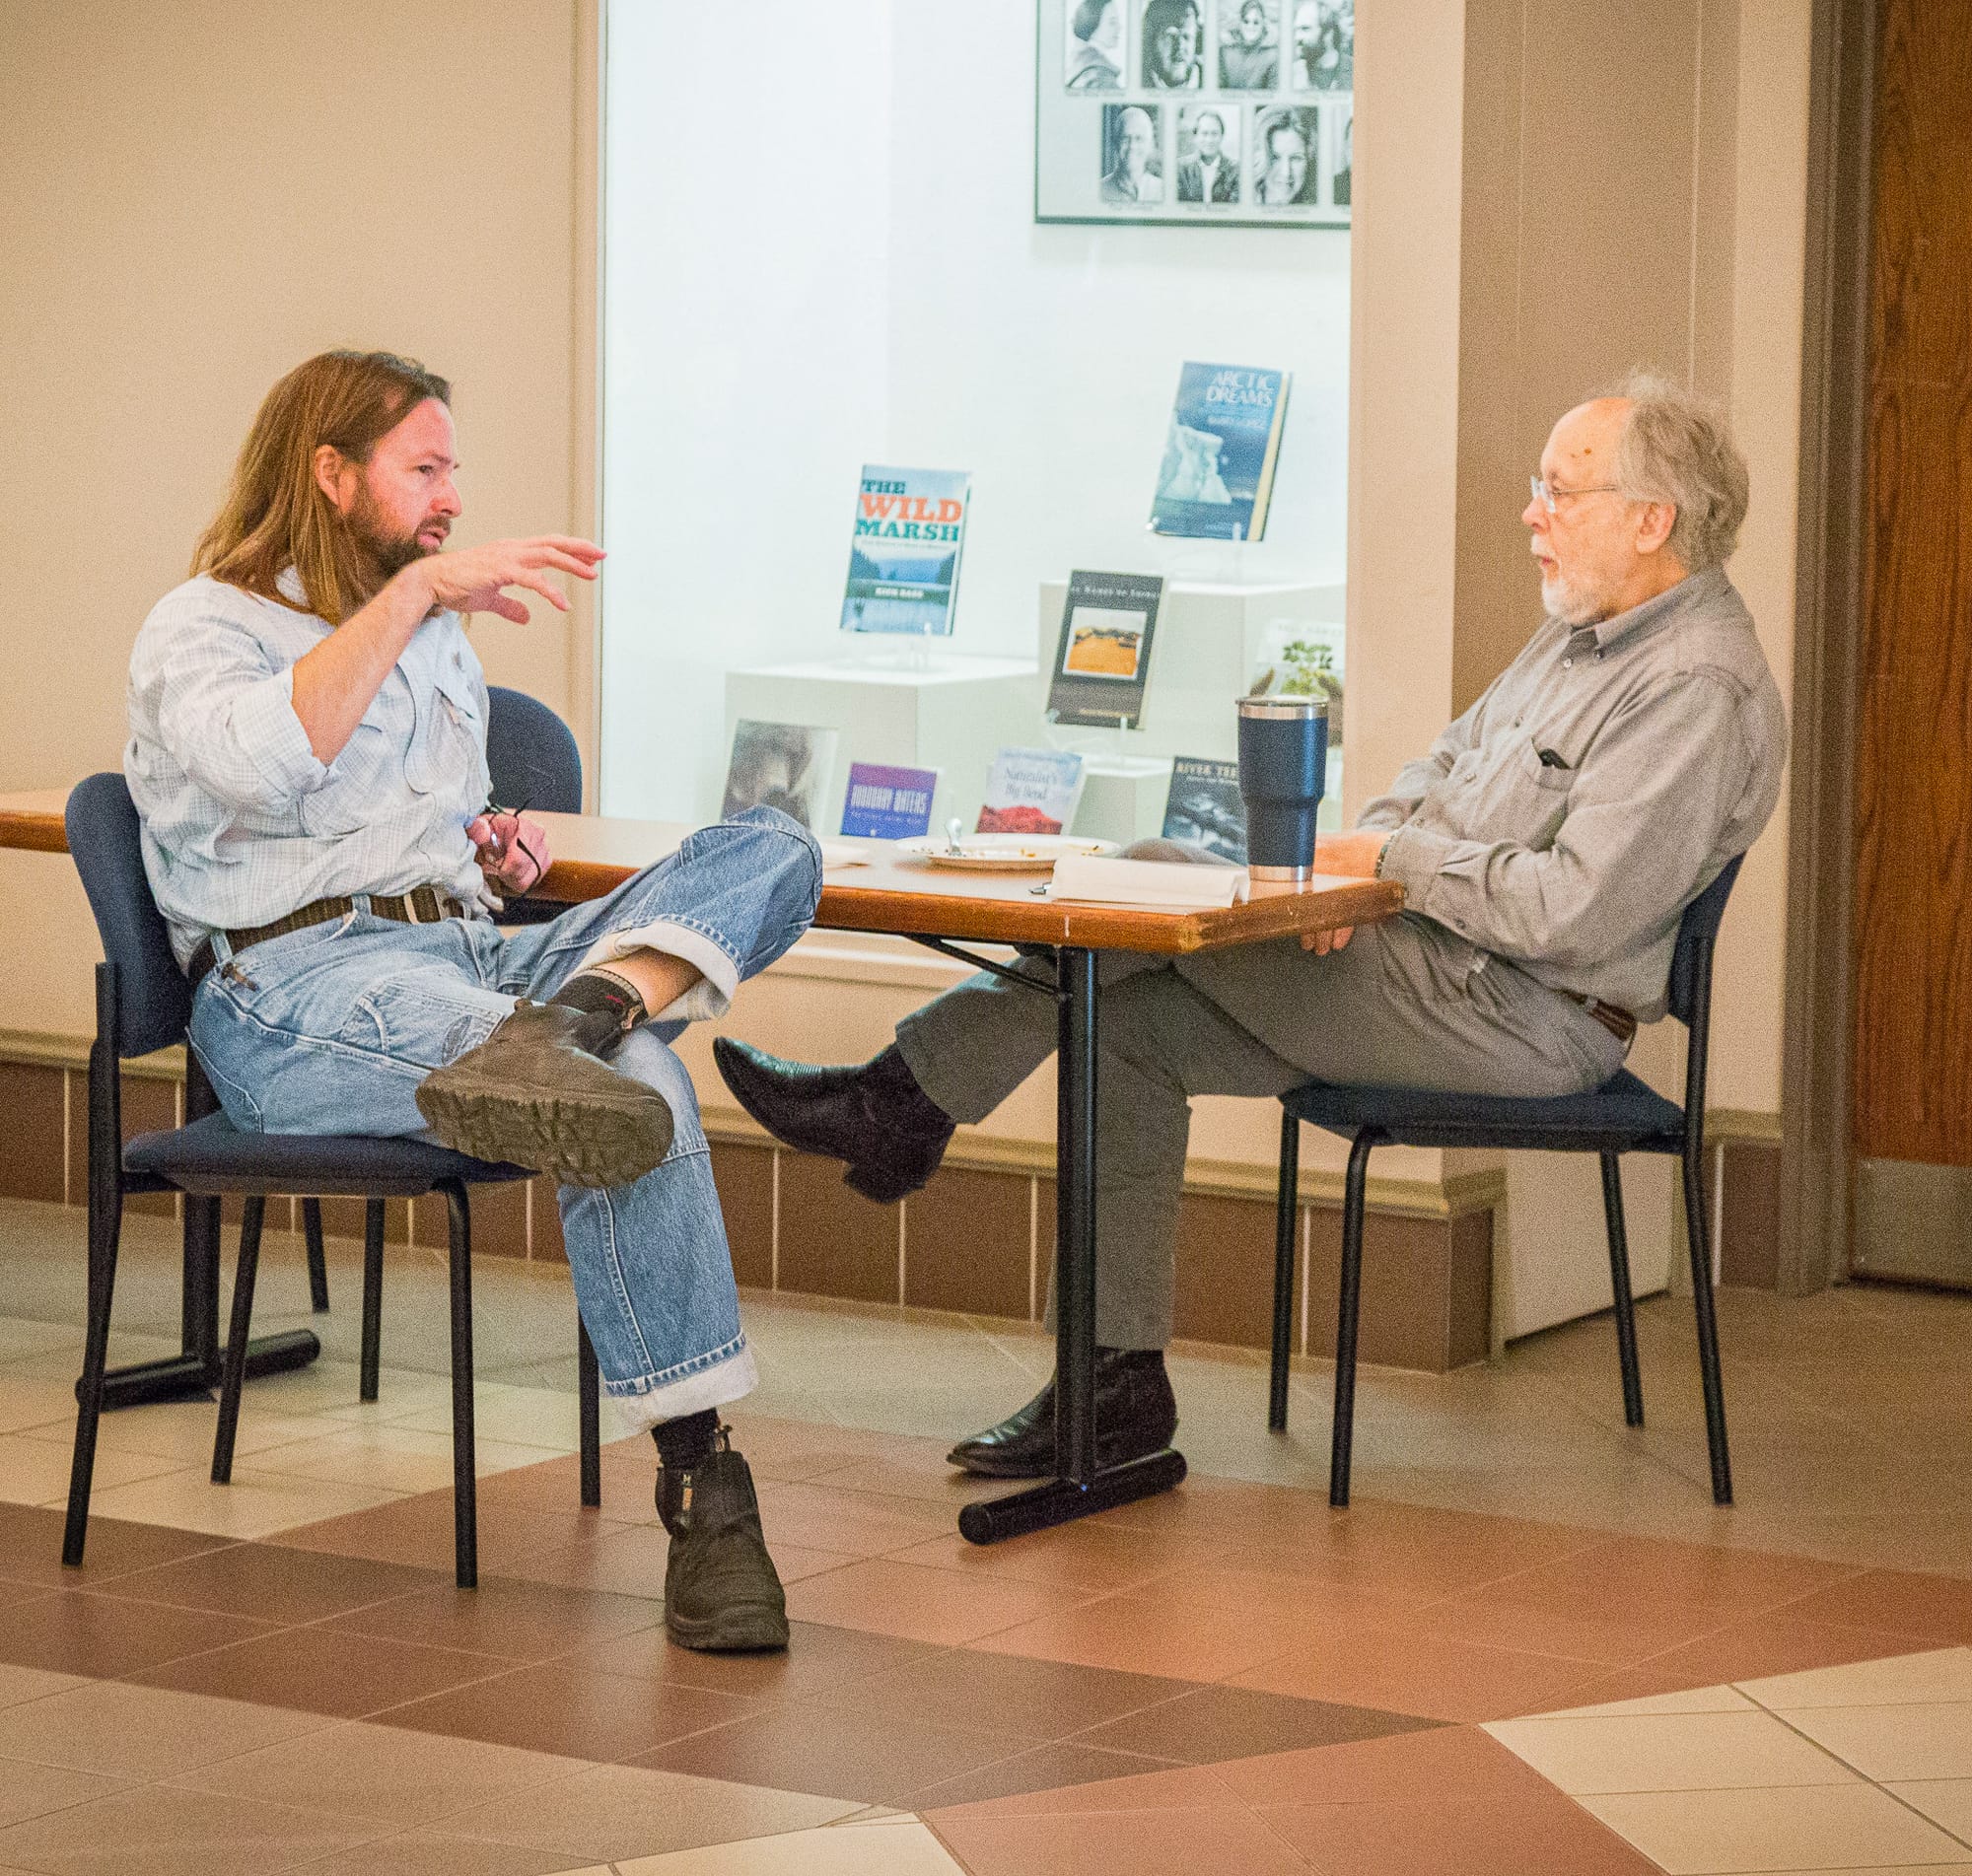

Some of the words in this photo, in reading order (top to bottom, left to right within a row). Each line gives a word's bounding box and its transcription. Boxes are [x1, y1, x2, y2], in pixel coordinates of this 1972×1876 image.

[1211, 370, 1275, 391] ARCTIC
[1205, 385, 1273, 408] DREAMS
[861, 479, 906, 495] THE
[860, 494, 962, 523] WILD
[855, 519, 959, 542] MARSH
